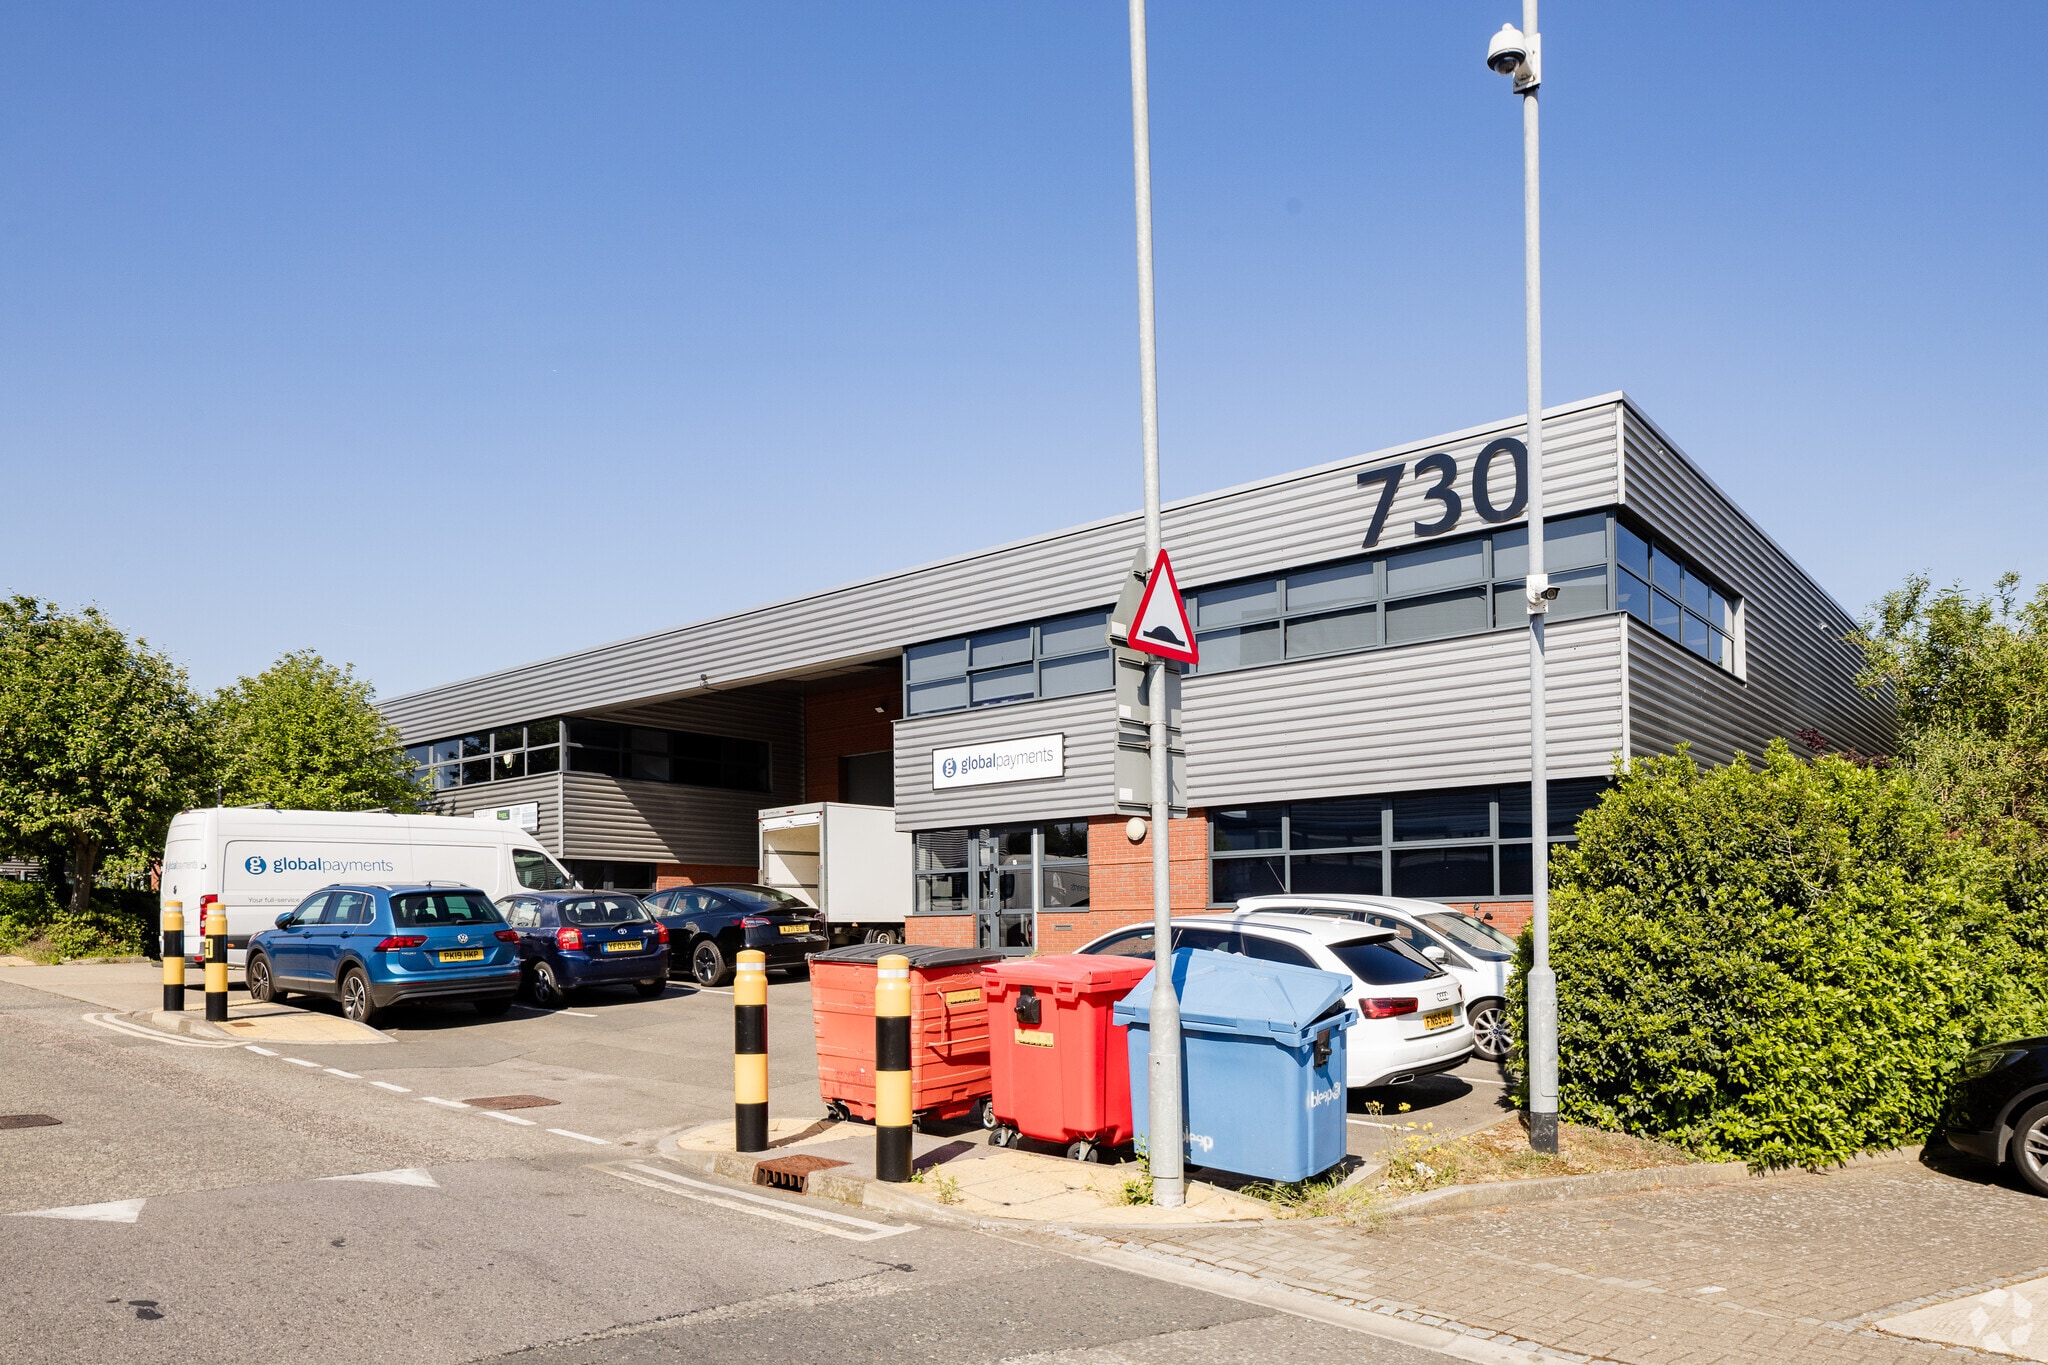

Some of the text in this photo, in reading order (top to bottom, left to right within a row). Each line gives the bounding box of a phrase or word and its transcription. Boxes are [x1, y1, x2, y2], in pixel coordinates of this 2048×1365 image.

[1357, 437, 1529, 548] 730
[961, 747, 1054, 775] globalpayments
[273, 856, 394, 874] globalpayments
[444, 950, 479, 960] PK19 HKP
